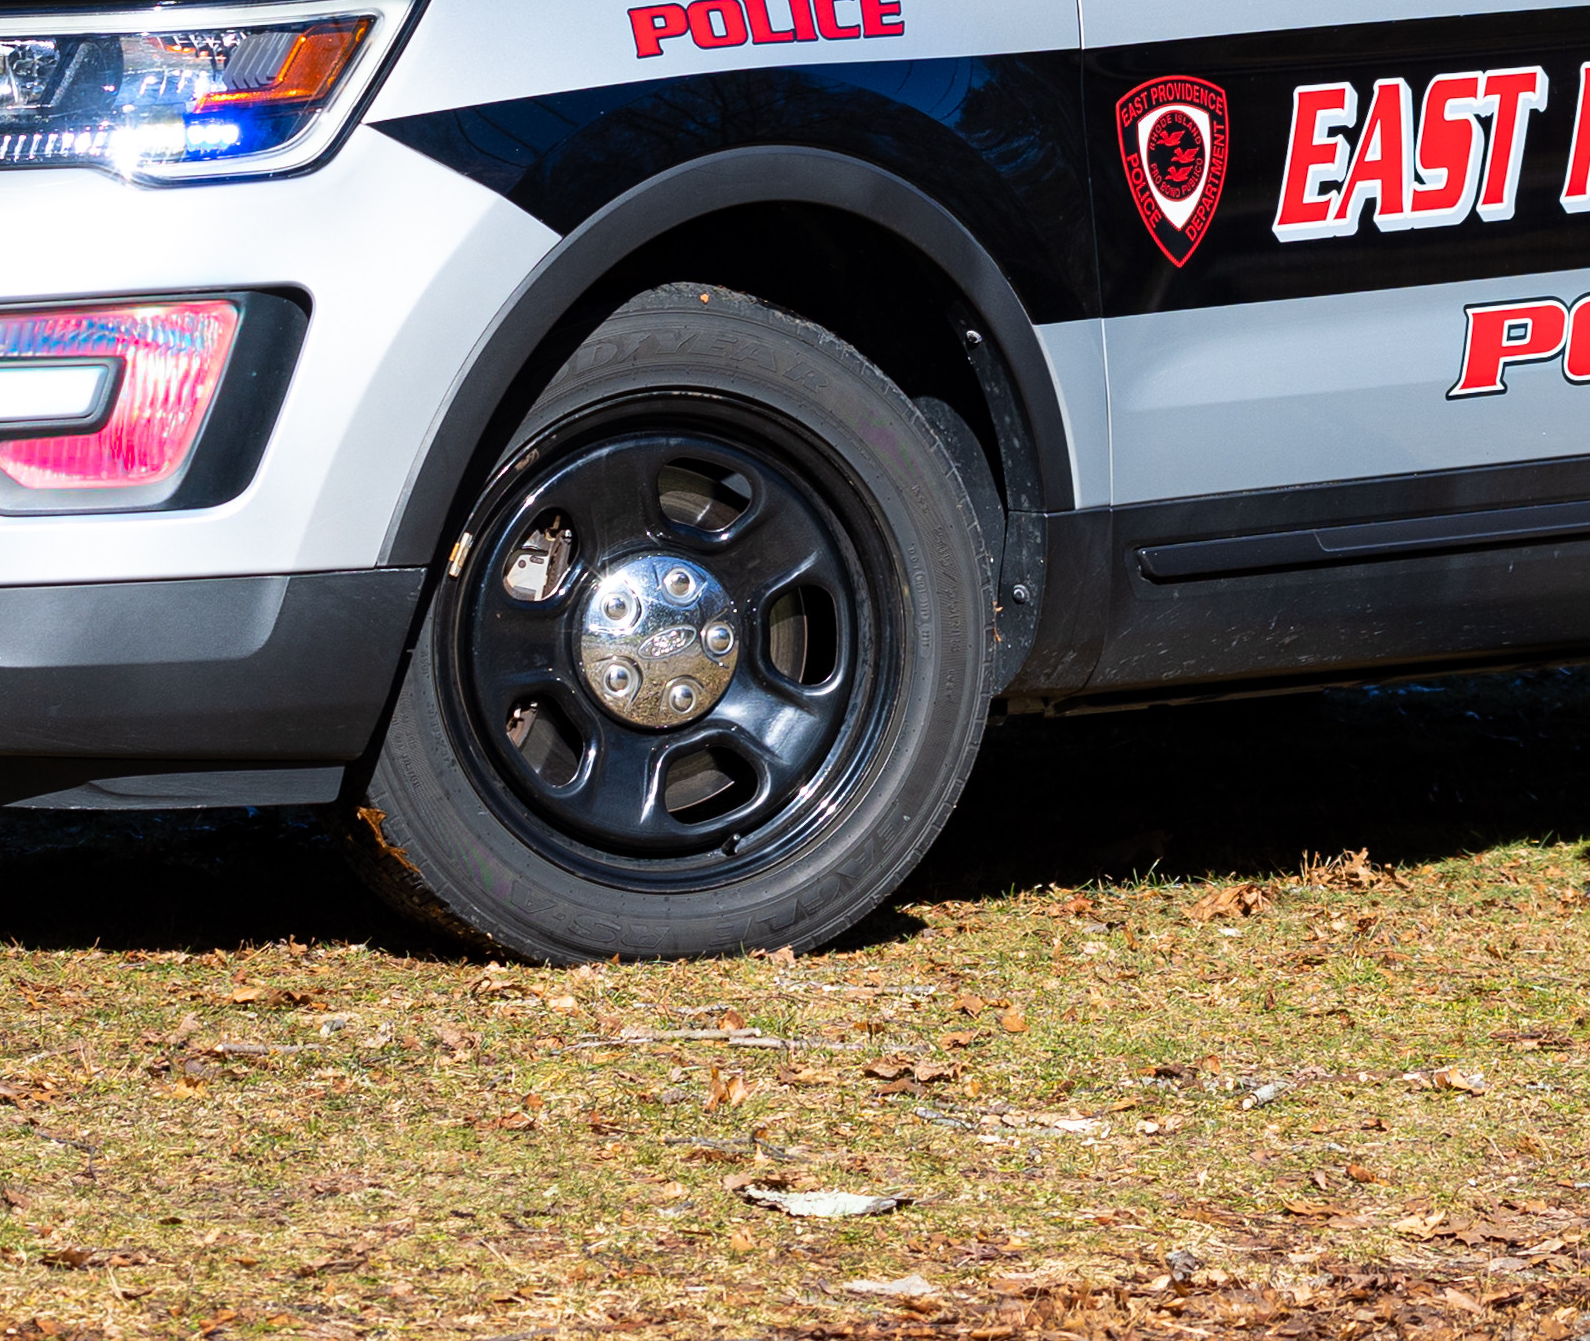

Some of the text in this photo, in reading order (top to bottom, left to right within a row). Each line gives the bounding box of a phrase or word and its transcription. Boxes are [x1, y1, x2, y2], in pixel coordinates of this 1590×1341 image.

[1121, 82, 1224, 128] EAST PROVIDENCE
[1149, 113, 1201, 150] RHODE ISLAND
[1272, 65, 1549, 242] EAST
[1127, 121, 1225, 241] POLICE DEPARTMENT
[1181, 157, 1203, 195] PUBLICO
